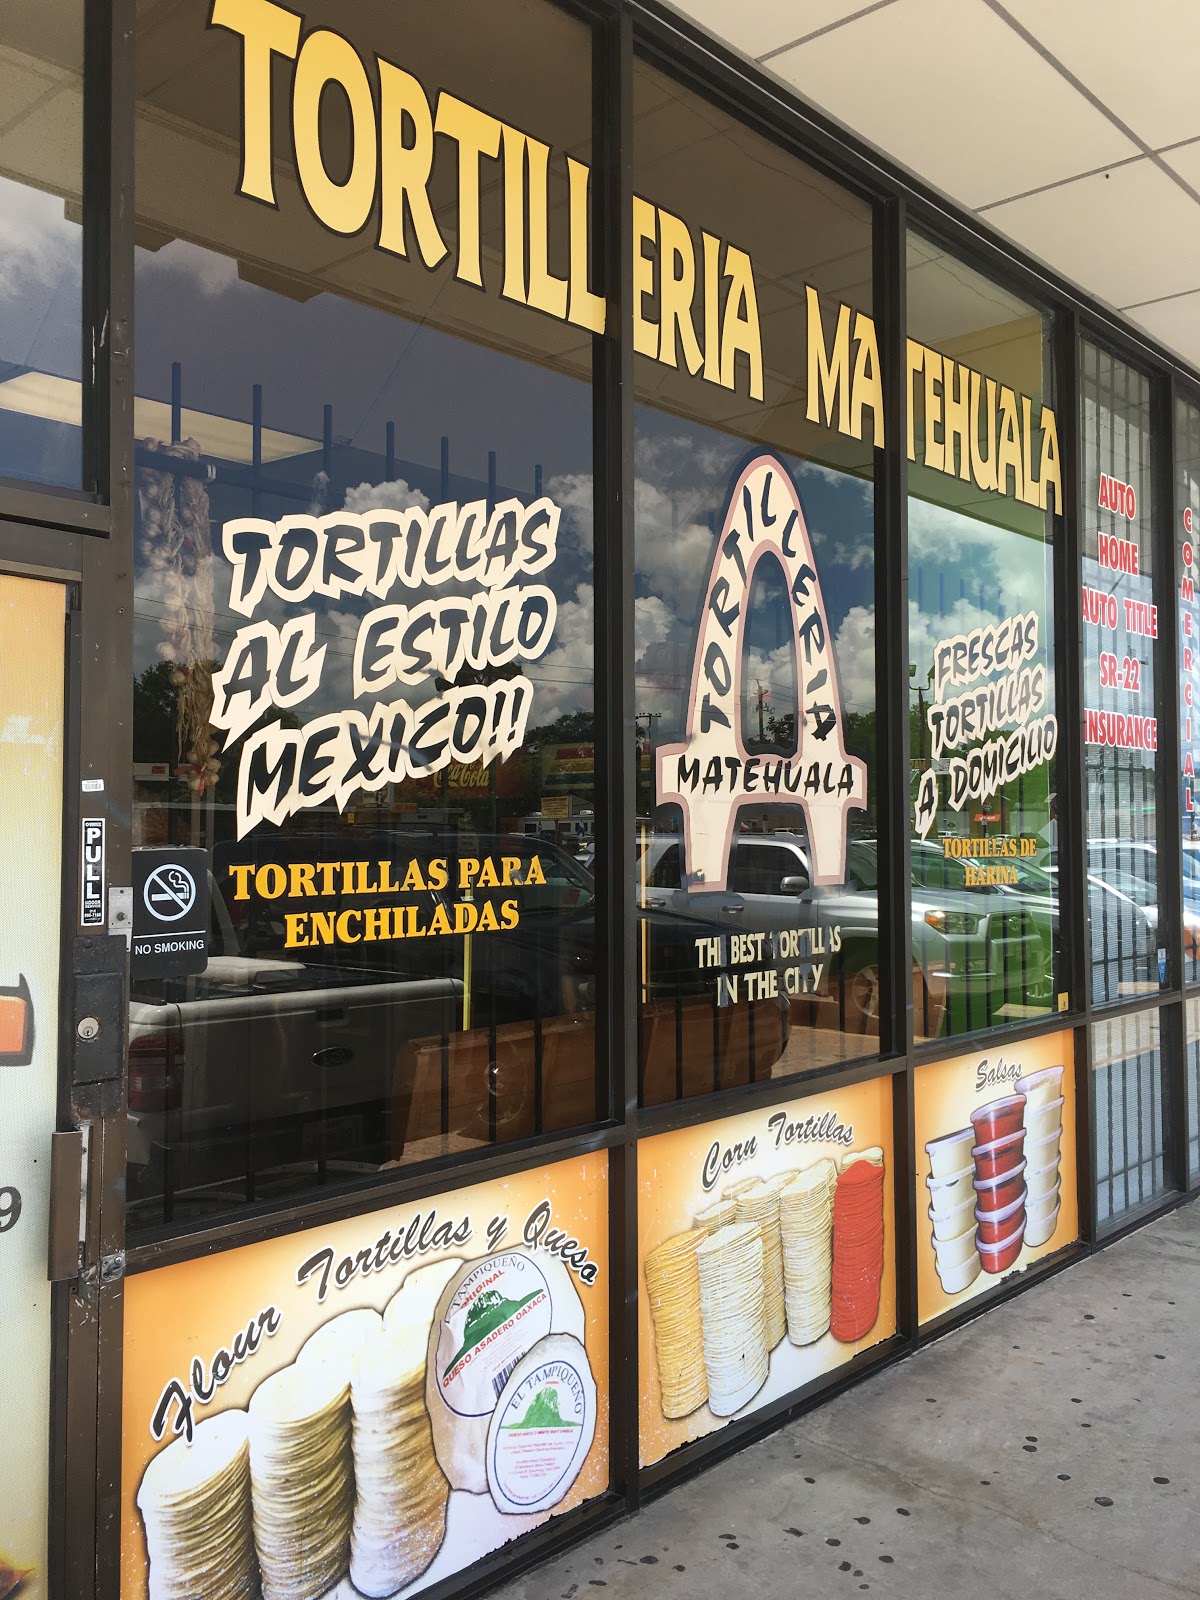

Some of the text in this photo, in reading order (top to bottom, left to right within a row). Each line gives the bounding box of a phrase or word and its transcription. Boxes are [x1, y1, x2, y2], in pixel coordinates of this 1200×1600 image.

[1098, 472, 1136, 520] AUTO
[228, 502, 555, 603] TORTILLAS
[1098, 532, 1139, 577] HOME
[700, 472, 836, 741] TORTILLERIA
[1082, 586, 1158, 639] AUTO TITLE
[215, 592, 552, 732] AL ESTILO
[936, 613, 1037, 696] FRESCAS
[1100, 652, 1140, 692] SR-22
[1181, 507, 1194, 813] COMERCIAL
[929, 666, 1044, 756] TORTILLAS
[1084, 708, 1158, 751] INSURANCE
[242, 681, 529, 830] MEXICO!!
[677, 754, 854, 798] MATEHUALA
[916, 717, 1056, 838] A DOMICILIO
[85, 827, 102, 899] PULL
[943, 838, 1037, 859] TORTILLAS DE
[228, 854, 547, 901] TORTILLAS PARA
[965, 865, 1018, 886] HARINA
[135, 939, 205, 955] NO SMOKING
[284, 899, 520, 948] ENCHILADAS
[695, 934, 727, 968] TH
[731, 932, 765, 965] BEST
[744, 969, 779, 1001] THE
[975, 1058, 1023, 1092] Salsas
[701, 1110, 855, 1190] Corn Tortillas
[152, 1201, 599, 1443] Flour Tortillas y Queso
[442, 1356, 472, 1389] QUESO
[474, 1319, 515, 1357] ASADERO
[515, 1293, 548, 1321] OAXACA
[511, 1391, 526, 1411] EL
